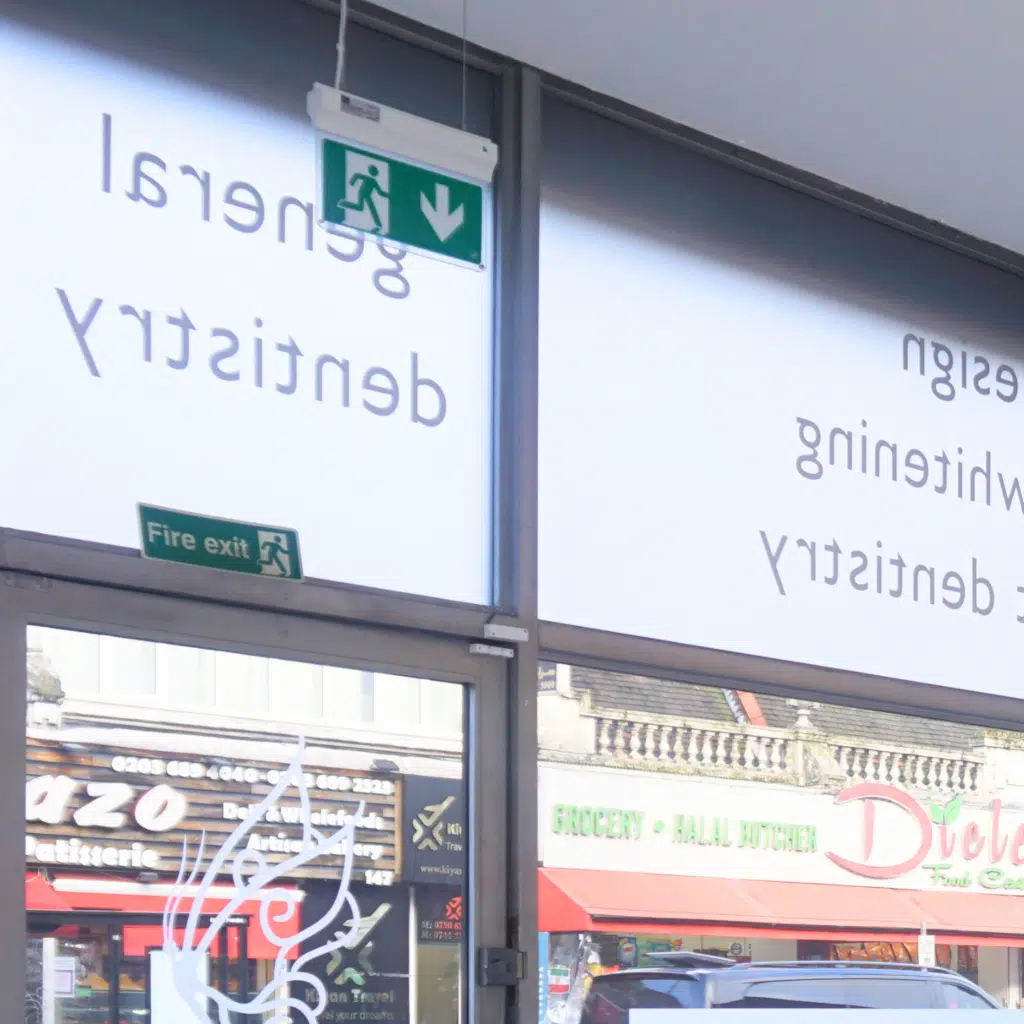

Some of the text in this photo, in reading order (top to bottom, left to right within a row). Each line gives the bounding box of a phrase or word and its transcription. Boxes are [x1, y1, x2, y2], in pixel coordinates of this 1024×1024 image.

[147, 521, 250, 560] Fire exit
[552, 803, 818, 854] GROCERY HALAL BUTCHER
[922, 863, 972, 888] Food
